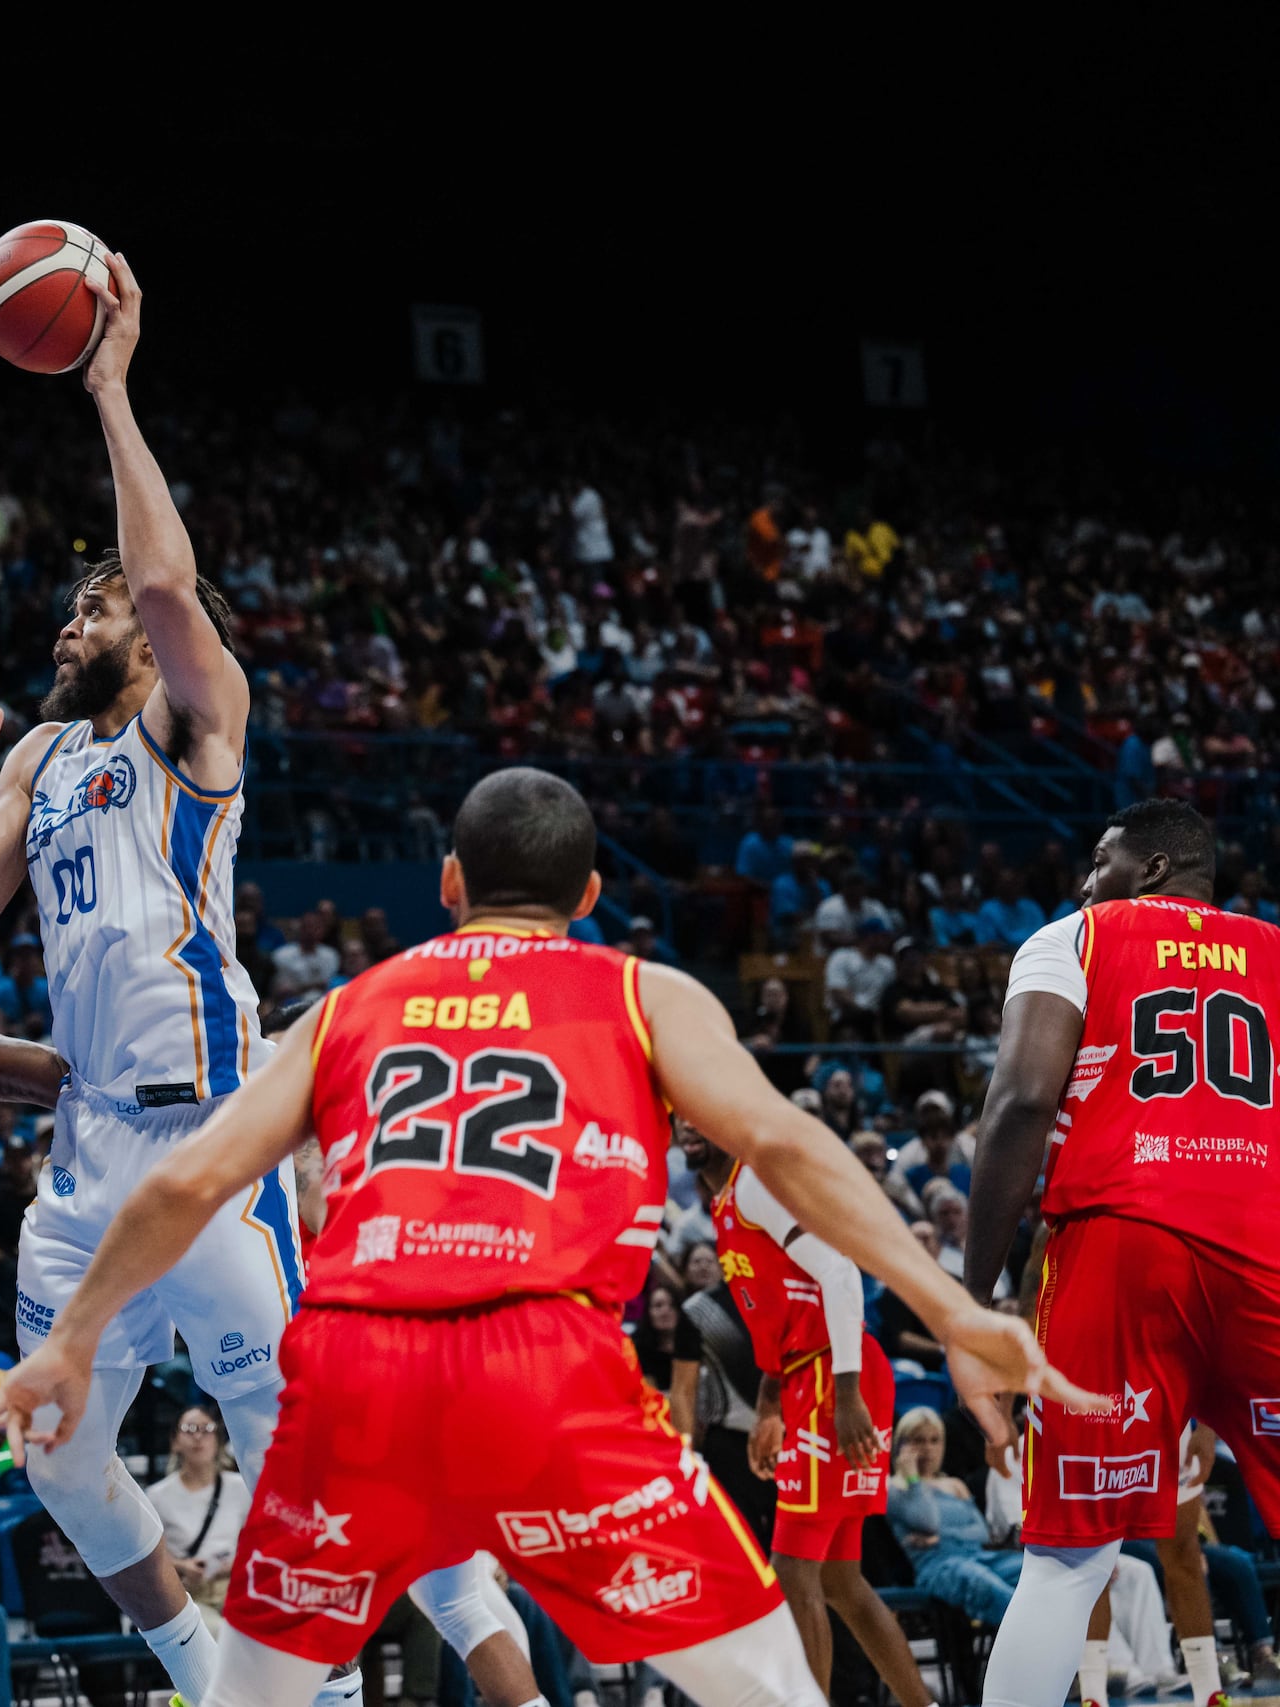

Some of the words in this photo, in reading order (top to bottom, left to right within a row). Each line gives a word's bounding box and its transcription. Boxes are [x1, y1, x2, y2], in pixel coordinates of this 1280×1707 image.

[434, 329, 464, 376] 6
[53, 846, 96, 925] 00
[1156, 939, 1247, 977] PENN
[402, 991, 531, 1031] SOSA
[1130, 987, 1274, 1109] 50
[1073, 1065, 1102, 1078] SPAÑA
[357, 1042, 566, 1200] 22
[1175, 1136, 1268, 1157] CARIBBEAN
[1175, 1151, 1266, 1168] UNIVERSITY
[17, 1290, 56, 1318] omas
[558, 1476, 674, 1533] bravo
